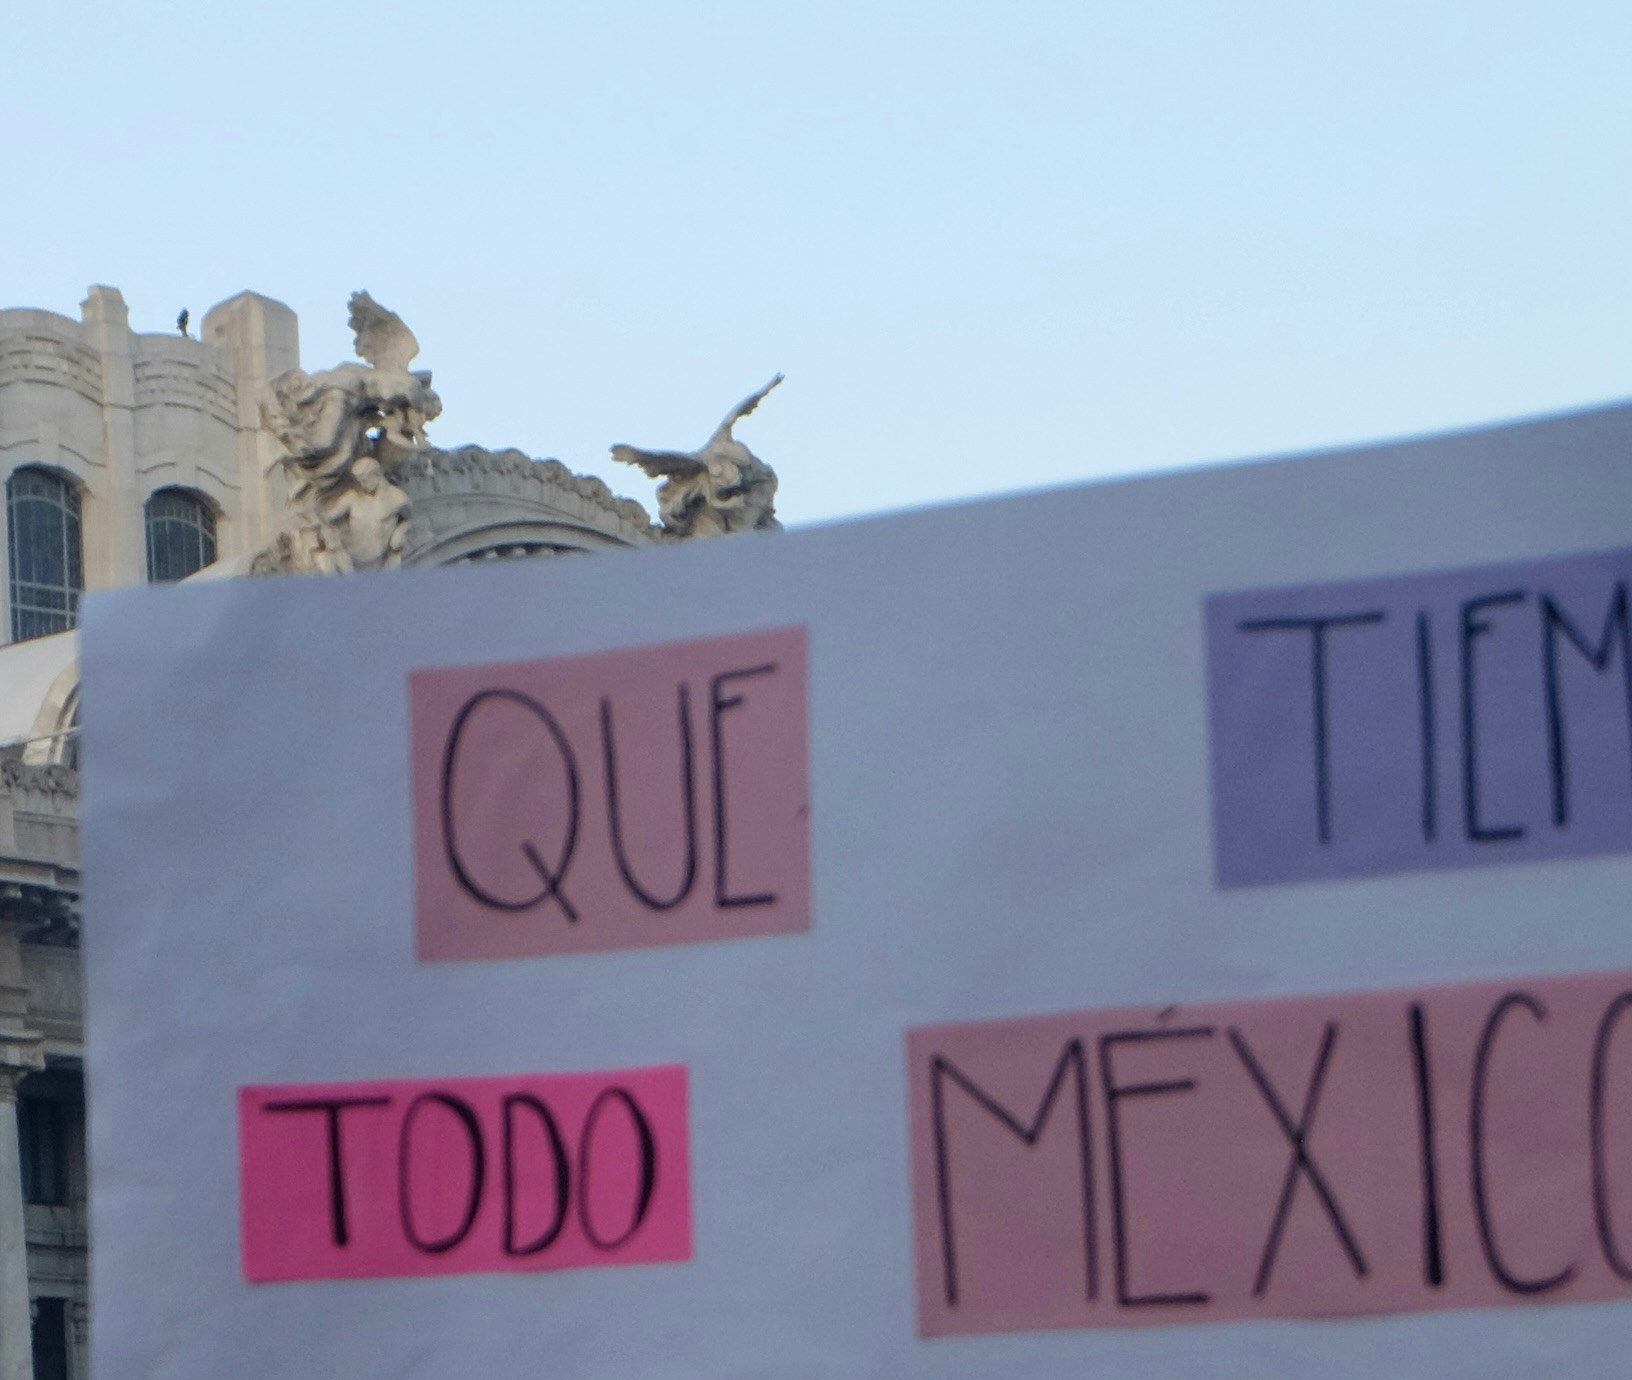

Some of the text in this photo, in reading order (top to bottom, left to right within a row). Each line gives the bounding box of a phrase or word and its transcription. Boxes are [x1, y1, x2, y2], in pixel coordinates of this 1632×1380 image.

[442, 581, 1632, 924] QUE TIEM
[261, 1086, 656, 1256] TODO
